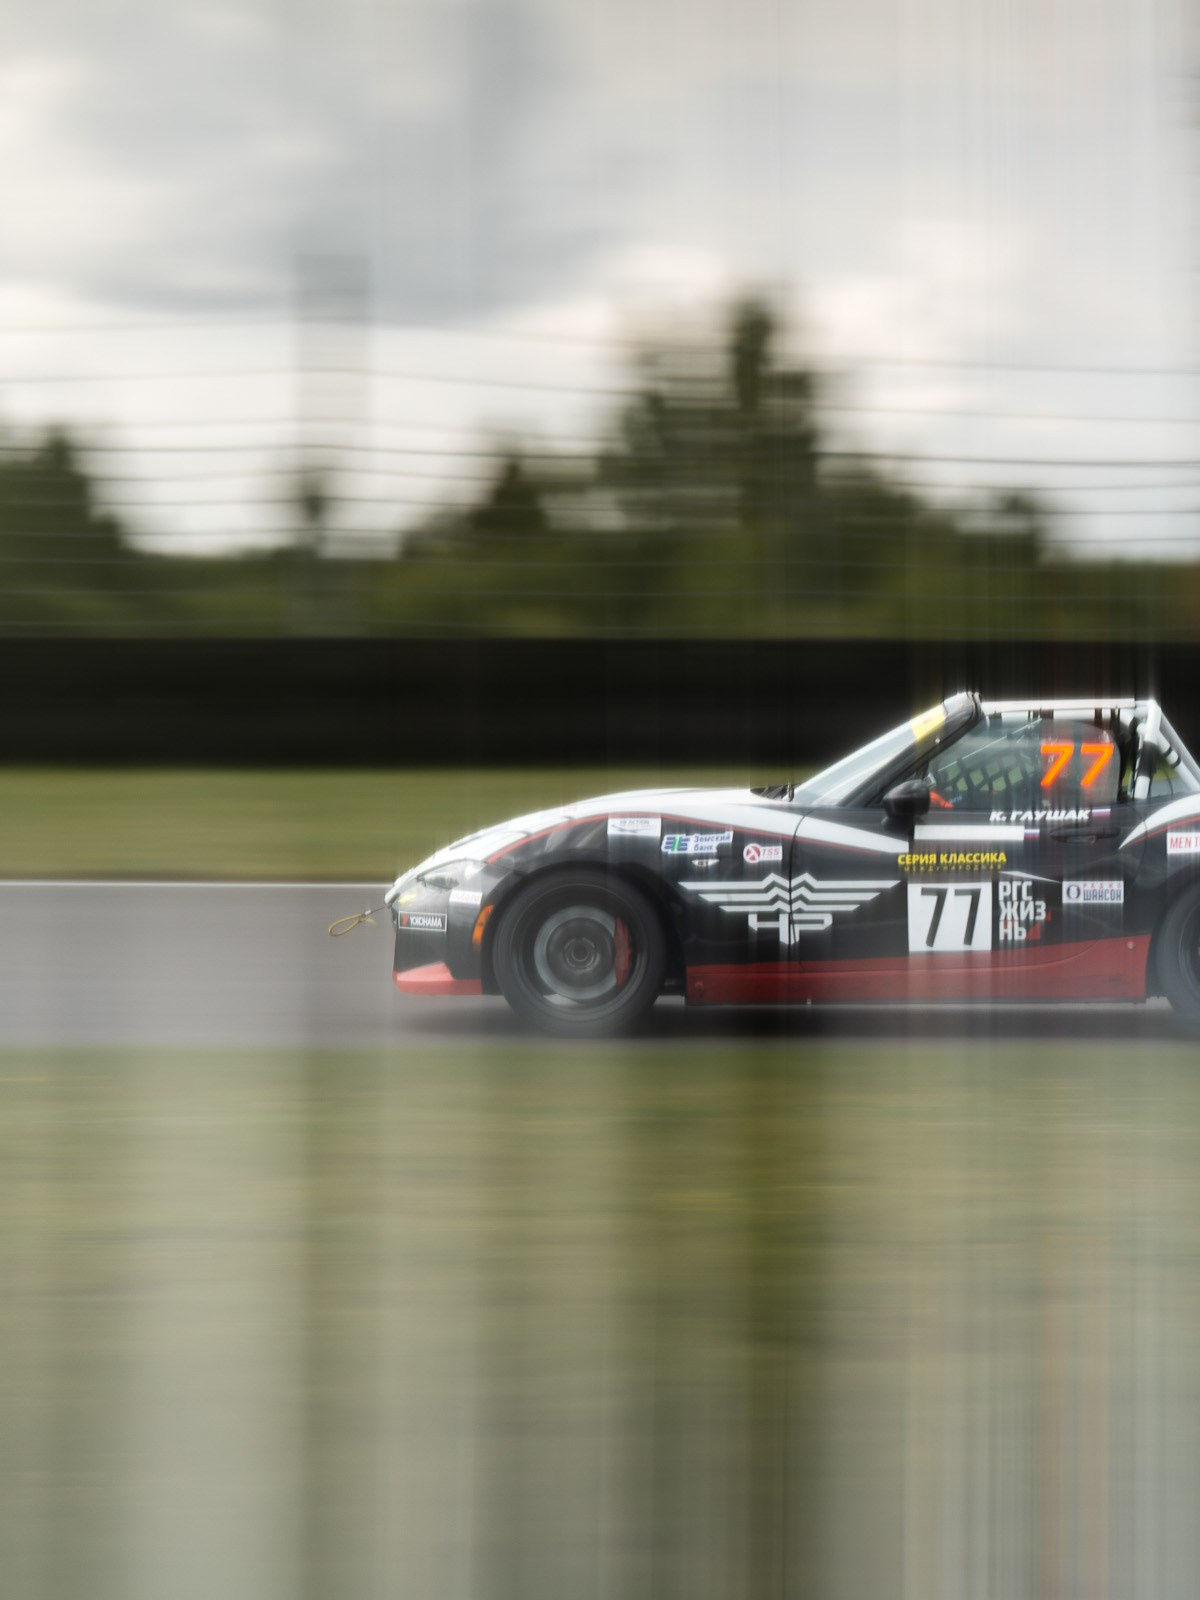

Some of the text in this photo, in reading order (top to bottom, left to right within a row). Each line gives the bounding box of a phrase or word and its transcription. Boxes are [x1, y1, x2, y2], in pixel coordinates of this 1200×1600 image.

[1041, 743, 1114, 787] 77
[1010, 810, 1090, 821] ГЛУШАК
[694, 834, 731, 843] Земский
[1170, 837, 1191, 848] MEN
[762, 848, 780, 856] TSS
[897, 852, 1007, 865] СЕРИЯ КЛАССИКА
[999, 881, 1033, 901] РГС
[1083, 889, 1122, 901] ШАНСОН
[1000, 901, 1046, 920] ЖИЗ
[409, 916, 442, 927] YOKOHAMA
[920, 887, 982, 947] 77
